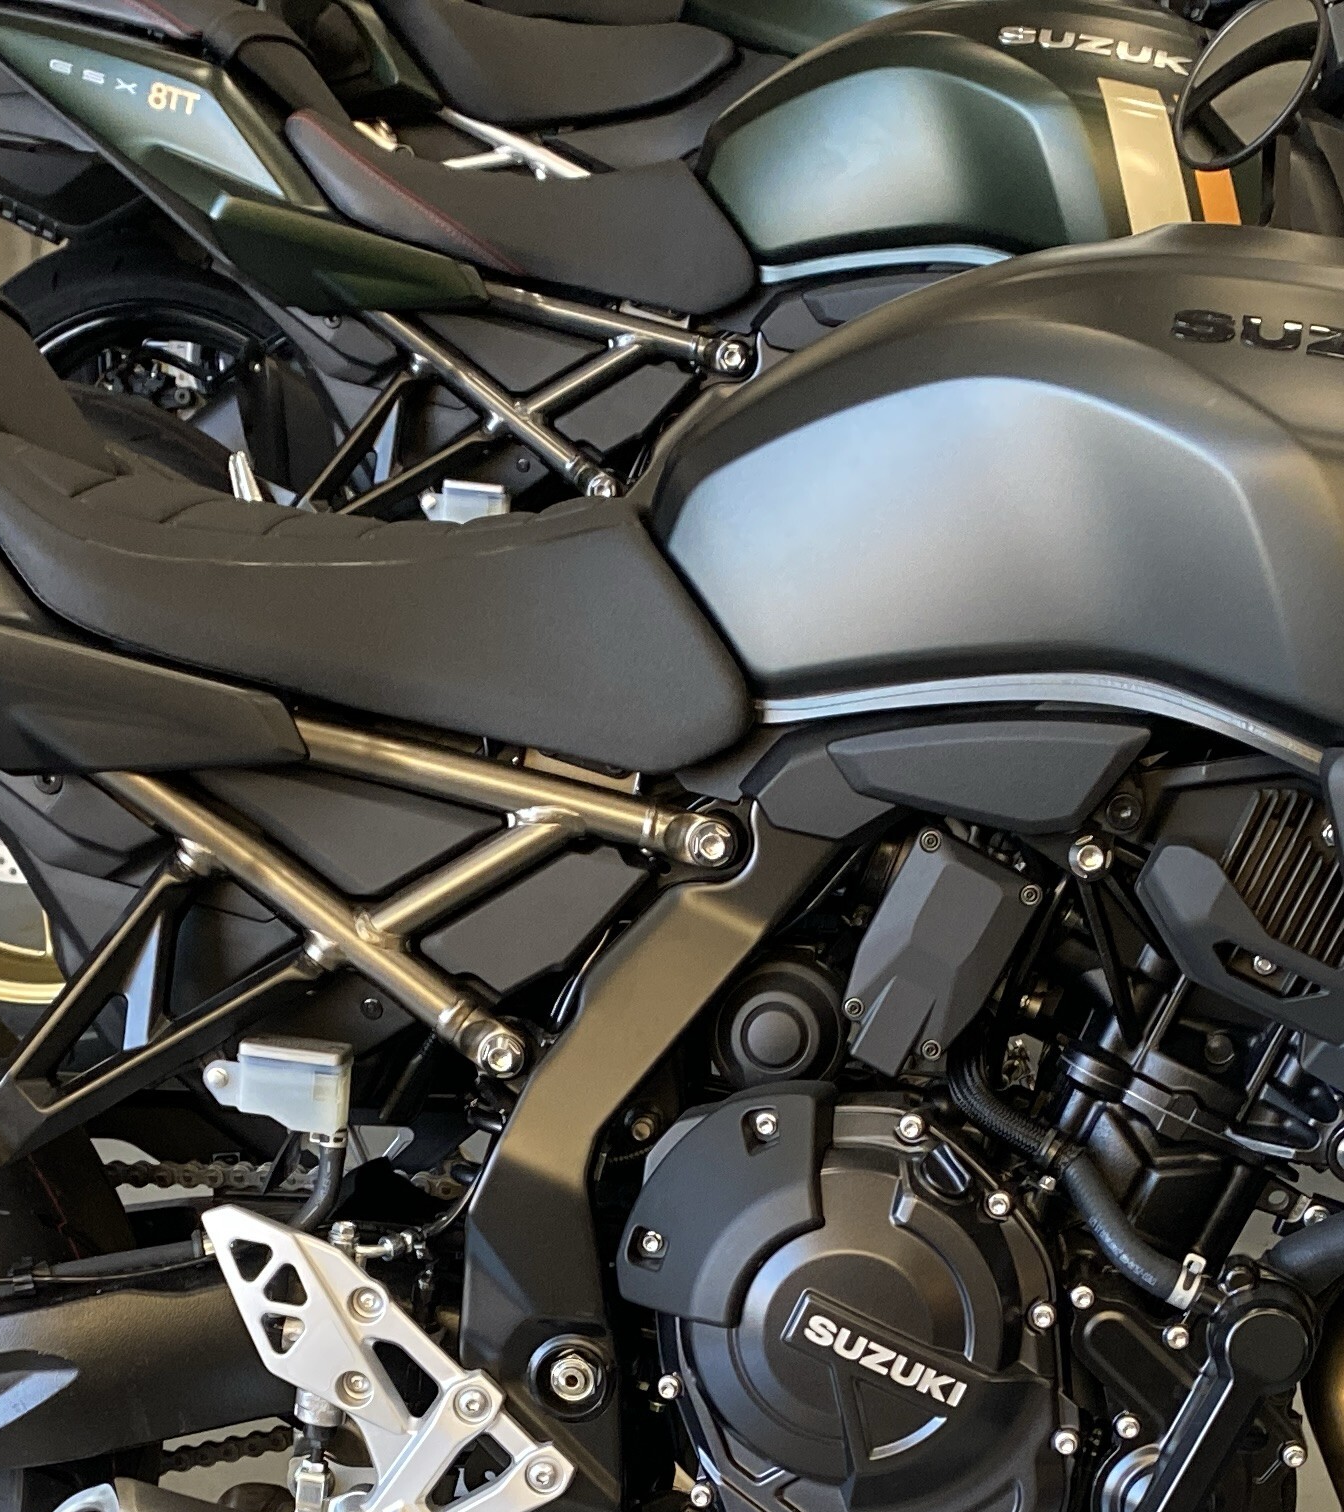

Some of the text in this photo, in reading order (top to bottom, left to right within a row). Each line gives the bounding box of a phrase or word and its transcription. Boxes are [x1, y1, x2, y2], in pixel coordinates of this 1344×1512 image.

[998, 25, 1193, 77] SUZUK
[147, 81, 202, 116] 8TT
[803, 1314, 968, 1408] SUZUKI
